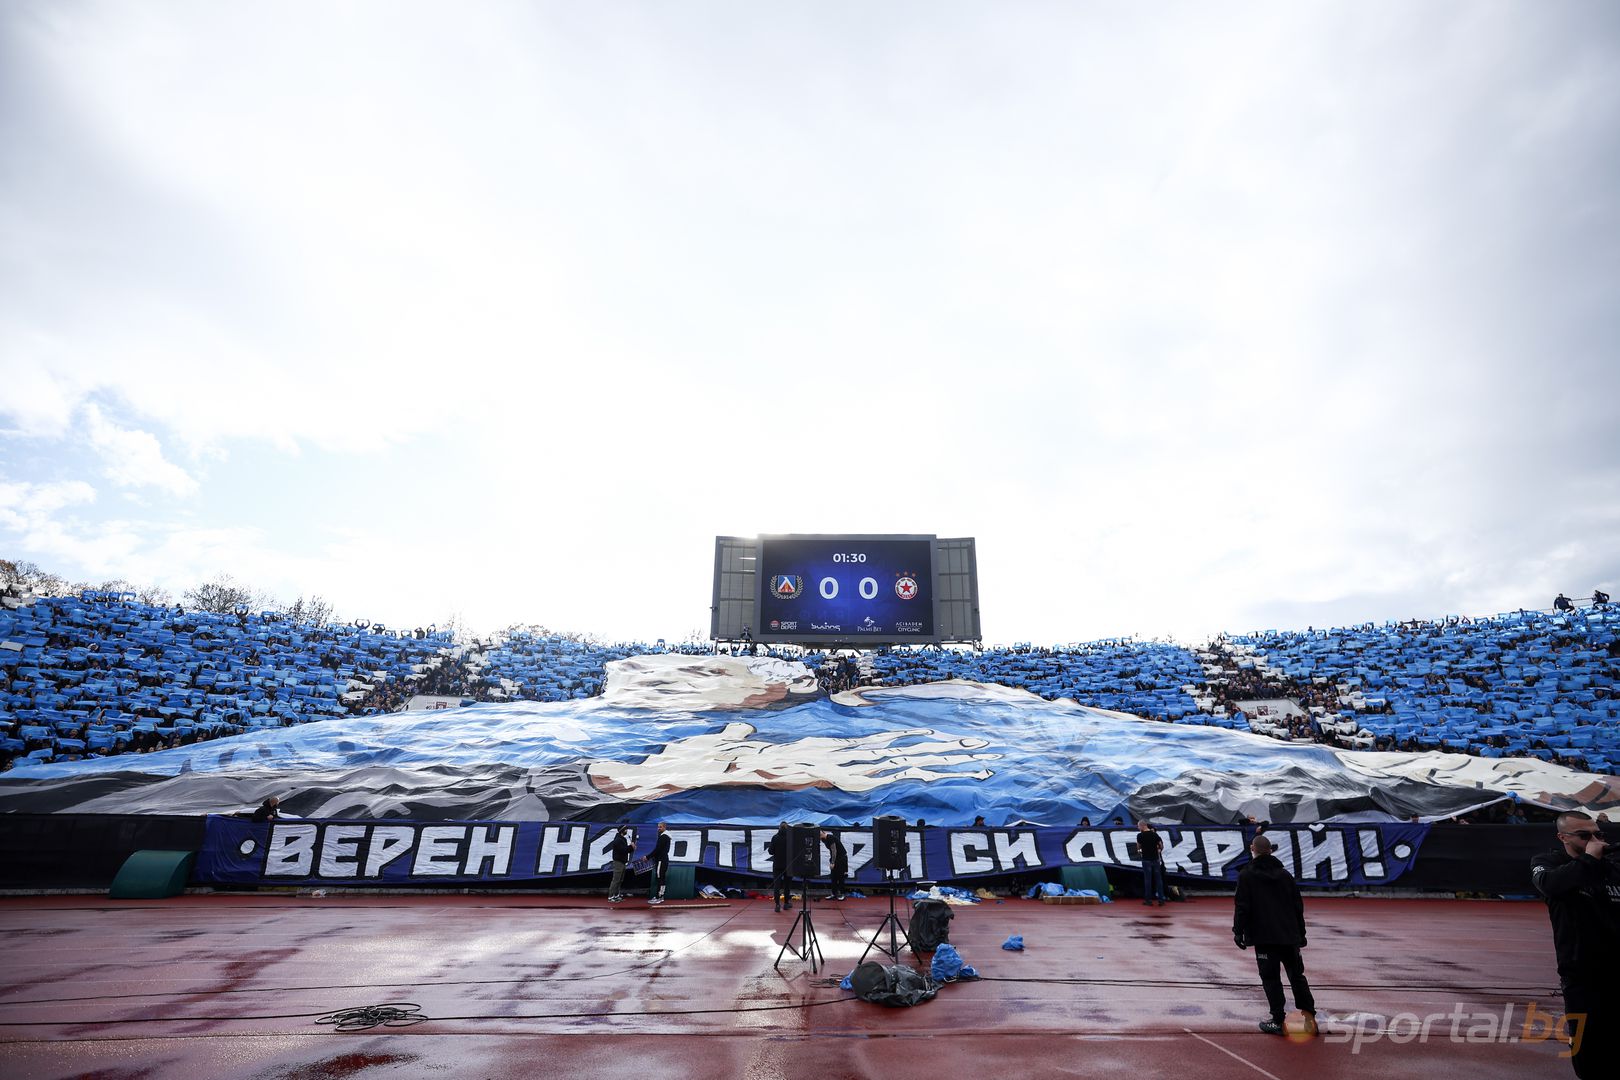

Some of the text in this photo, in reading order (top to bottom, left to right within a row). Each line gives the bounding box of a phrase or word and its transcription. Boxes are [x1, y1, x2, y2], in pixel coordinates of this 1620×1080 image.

[833, 553, 867, 563] 01:30
[819, 576, 879, 600] 0 0
[263, 824, 515, 877] ВЕРЕН
[538, 827, 633, 873] НА
[951, 831, 1042, 875] СИ
